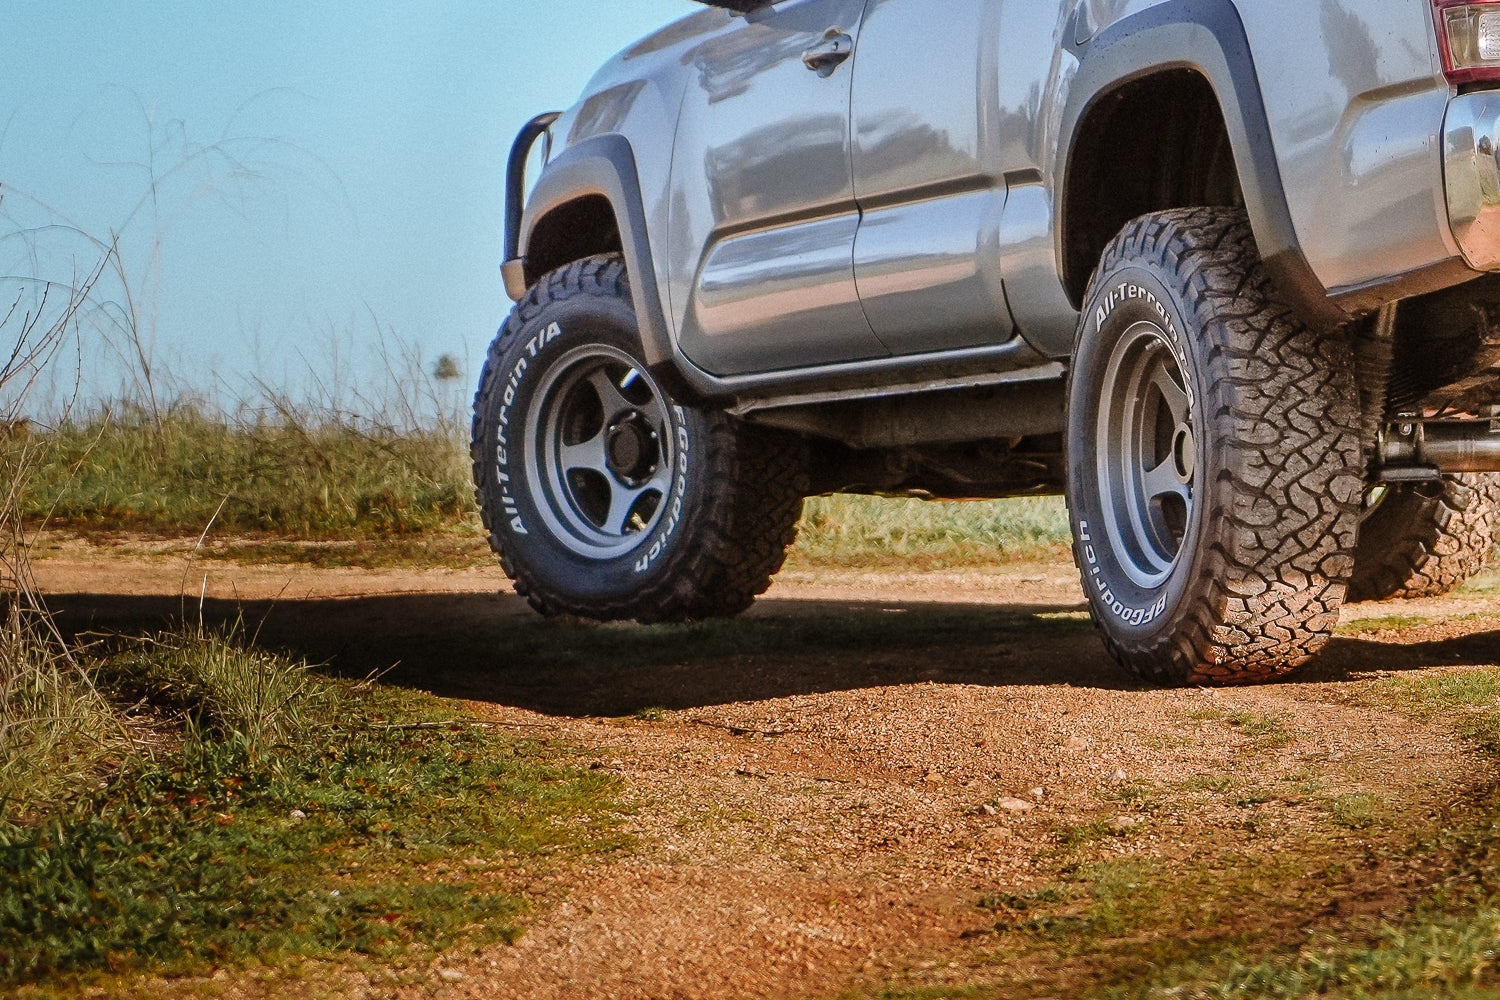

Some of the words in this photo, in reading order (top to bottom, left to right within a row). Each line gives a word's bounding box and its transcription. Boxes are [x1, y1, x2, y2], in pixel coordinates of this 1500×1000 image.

[1096, 282, 1178, 343] All-Terrain
[496, 357, 529, 535] All-Terrain
[525, 321, 561, 357] T/A
[635, 403, 689, 572] FGoodrich
[1080, 520, 1168, 626] BFGoodrich
